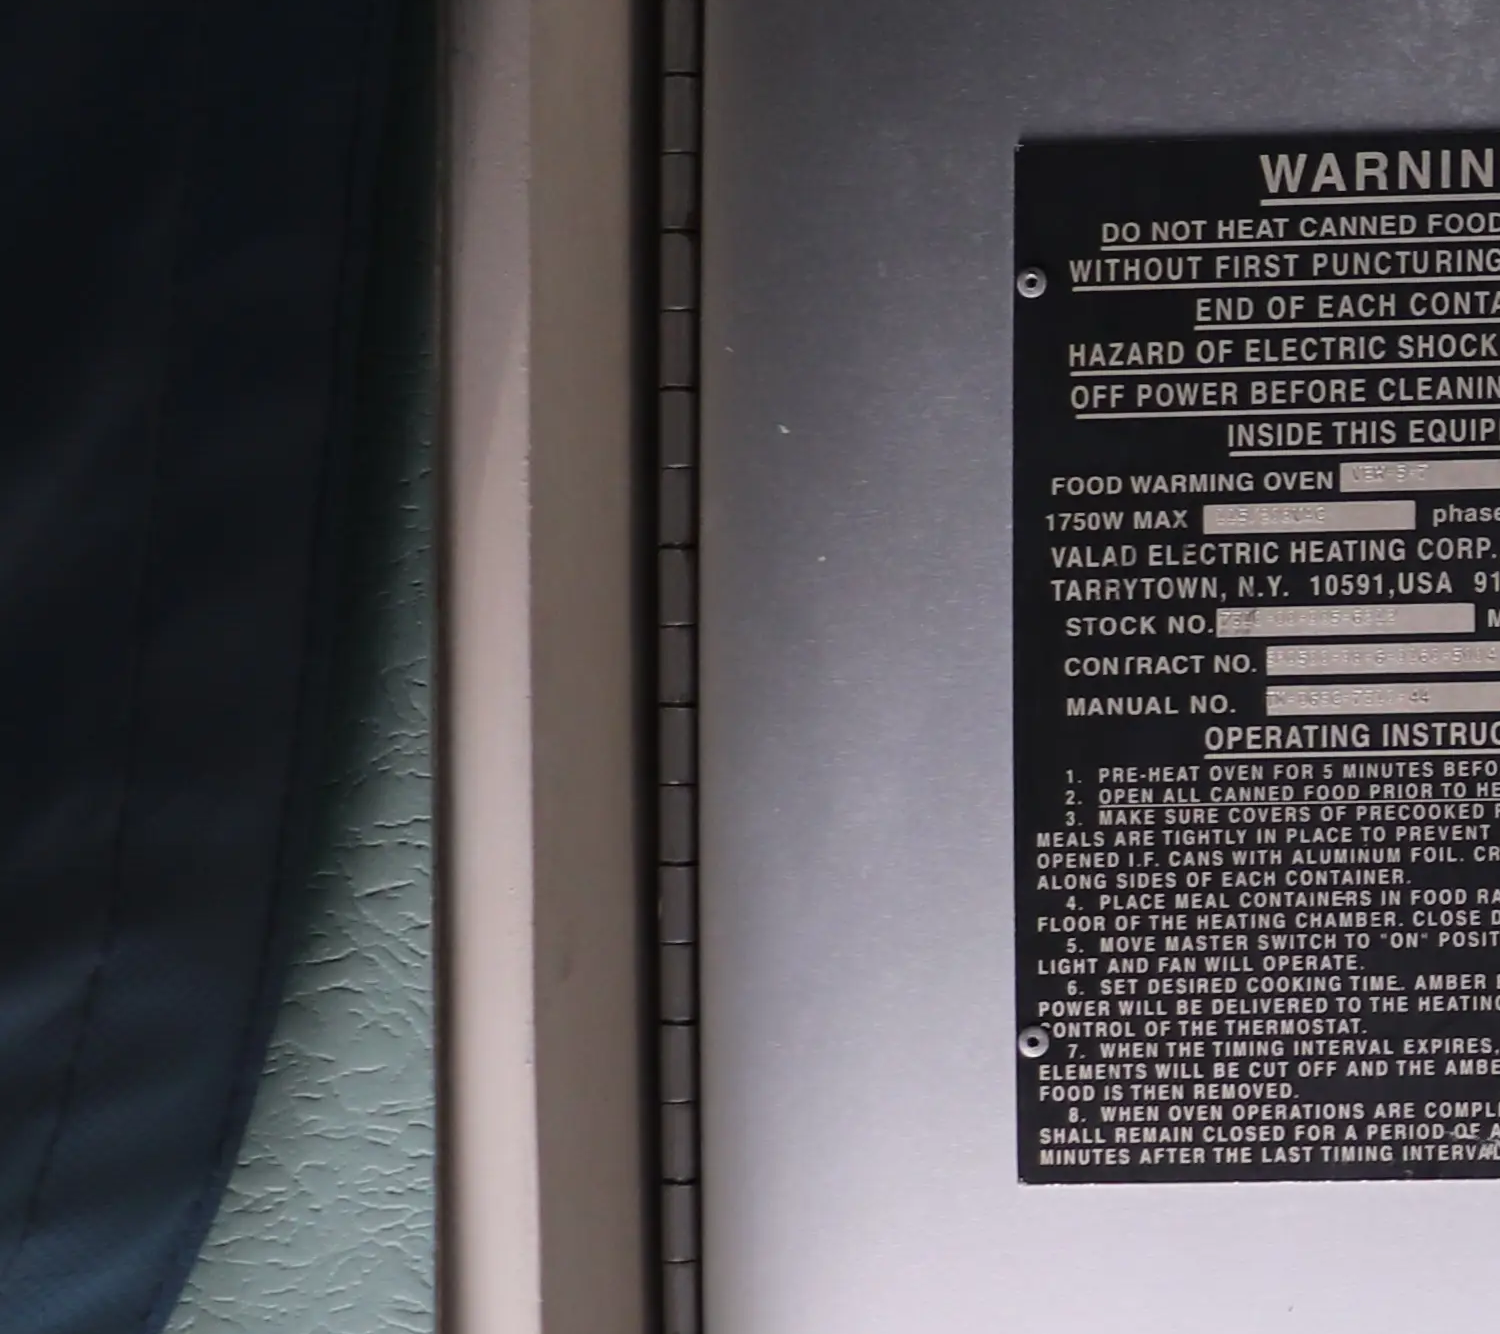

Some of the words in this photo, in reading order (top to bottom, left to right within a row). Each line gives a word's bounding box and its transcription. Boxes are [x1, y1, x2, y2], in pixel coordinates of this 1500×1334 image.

[1101, 220, 1141, 244] DO
[1150, 219, 1208, 243] NOT
[1216, 216, 1291, 241] HEAT
[1298, 213, 1418, 239] CANNED
[1068, 255, 1204, 284] WITHOUT
[1215, 252, 1301, 280] FIRST
[1195, 296, 1255, 323] END
[1266, 294, 1306, 321] OF
[1317, 292, 1397, 320] EACH
[1068, 339, 1186, 368] HAZARD
[1195, 338, 1234, 365] OF
[1244, 334, 1387, 364] ELECTRIC
[1396, 332, 1499, 360] SHOCK
[1070, 383, 1126, 411] OFF
[1136, 380, 1239, 408] POWER
[1250, 377, 1367, 406] BEFORE
[1227, 420, 1324, 449] INSIDE
[1330, 418, 1397, 446] THIS
[1050, 475, 1124, 497] FOOD
[1129, 471, 1255, 495] WARMING
[1262, 470, 1334, 492] OVEN
[1044, 510, 1125, 533] 1750W
[1132, 508, 1189, 531] MAX
[1050, 544, 1138, 569] VALAD
[1147, 540, 1280, 568] ELECTRIC
[1289, 537, 1407, 565] HEATING
[1049, 575, 1227, 603] TARRYTOWN,
[1237, 574, 1290, 598] N.Y.
[1065, 614, 1157, 638] STOCK
[1167, 613, 1215, 635] NO.
[1213, 652, 1258, 674] NO.
[1066, 695, 1180, 717] MANUAL
[1189, 693, 1237, 715] NO.
[1204, 722, 1371, 752] OPERATING
[1065, 768, 1083, 785] 1.
[1098, 764, 1201, 784] PRE-HEAT
[1208, 763, 1265, 783] OVEN
[1272, 762, 1315, 781] FOR
[1322, 762, 1334, 781] 5
[1341, 760, 1435, 780] MINUTES
[1064, 789, 1083, 806] 2.
[1097, 786, 1154, 806] OPEN
[1161, 786, 1202, 804] ALL
[1209, 784, 1295, 804] CANNED
[1302, 783, 1361, 802] FOOD
[1368, 781, 1434, 800] PRIOR
[1439, 781, 1468, 800] TO
[1064, 809, 1083, 828] 3.
[1098, 808, 1156, 827] MAKE
[1163, 806, 1220, 826] SURE
[1227, 805, 1312, 825] COVERS
[1319, 804, 1348, 823] OF
[1355, 802, 1486, 822] PRECOOKED
[1036, 872, 1108, 891] ALONG
[1115, 870, 1178, 891] SIDES
[1185, 870, 1213, 889] OF
[1221, 870, 1277, 889] EACH
[1284, 867, 1412, 888] CONTAINER.
[1036, 914, 1107, 934] FLOOR
[1113, 914, 1142, 933] OF
[1147, 913, 1189, 932] THE
[1195, 911, 1287, 931] HEATING
[1294, 910, 1405, 930] CHAMBER.
[1411, 908, 1482, 928] CLOSE
[1065, 936, 1085, 955] 5.
[1099, 935, 1157, 954] MOVE
[1164, 933, 1250, 953] MASTER
[1256, 932, 1338, 952] SWITCH
[1343, 931, 1371, 950] TO
[1066, 978, 1085, 997] 6.
[1099, 977, 1140, 997] SET
[1146, 976, 1238, 996] DESIRED
[1245, 974, 1343, 995] COOKING
[1348, 974, 1406, 993] TIME.
[1413, 972, 1487, 992] AMBER
[1143, 1019, 1172, 1038] OF
[1176, 1019, 1219, 1038] THE
[1223, 1017, 1368, 1037] THERMOSTAT.
[1038, 1084, 1096, 1103] FOOD
[1103, 1083, 1124, 1102] IS
[1128, 1083, 1185, 1102] THEN
[1192, 1081, 1300, 1101] REMOVED.
